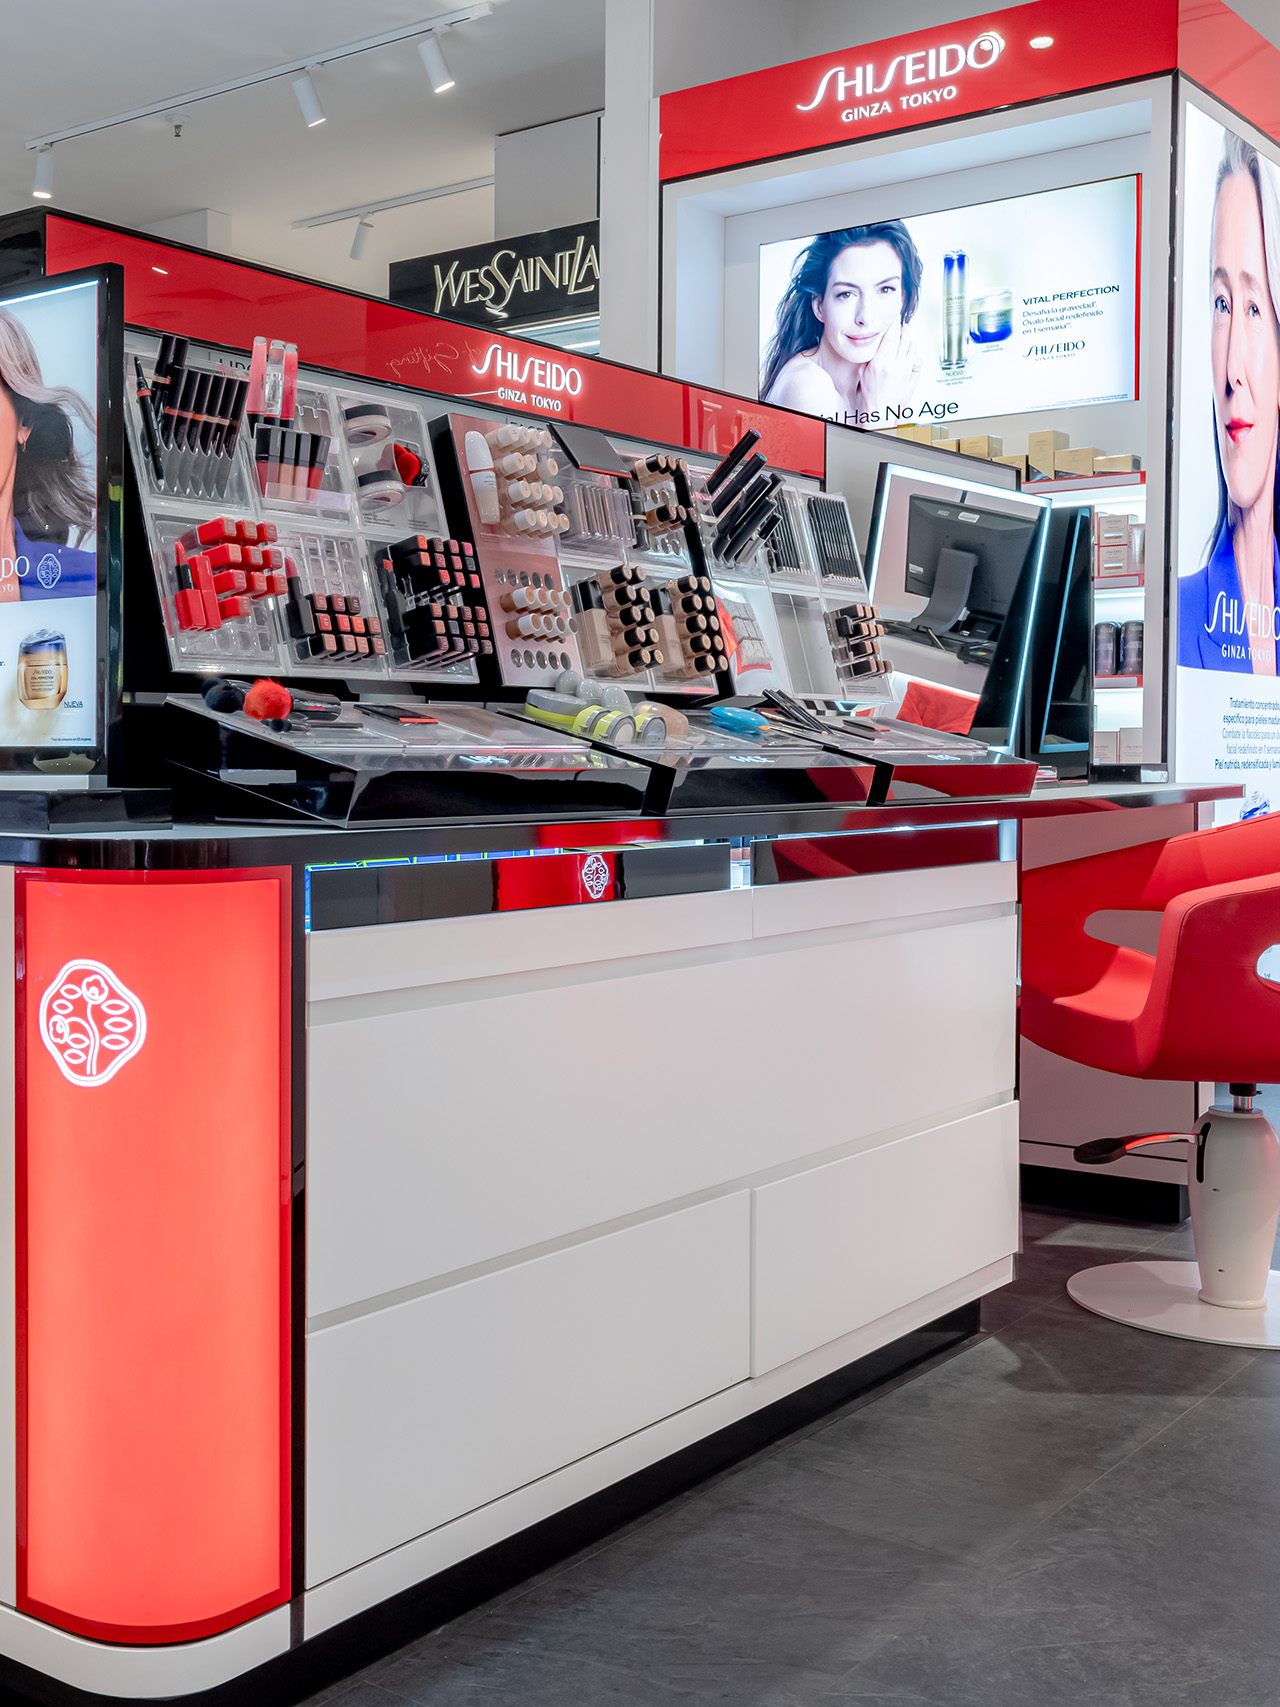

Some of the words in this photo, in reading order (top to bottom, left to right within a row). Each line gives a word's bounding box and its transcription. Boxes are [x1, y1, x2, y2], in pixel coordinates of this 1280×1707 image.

[796, 35, 1003, 111] SHISEIDO
[841, 101, 892, 123] GINZA
[900, 85, 958, 110] TOKYO
[1022, 296, 1051, 305] VITAL
[1052, 285, 1120, 301] PERFECTION
[1045, 314, 1065, 323] facial
[1065, 309, 1104, 320] redefinido
[1022, 340, 1086, 358] SHISEIDO
[472, 343, 583, 396] SHISEIDO
[497, 386, 528, 405] GINZA
[530, 394, 562, 412] TOKYO
[844, 409, 881, 425] Has
[885, 404, 914, 421] No
[918, 401, 959, 419] Age
[1221, 643, 1246, 659] GINZA
[1247, 647, 1272, 662] TOKYO
[63, 700, 83, 708] NUEVA
